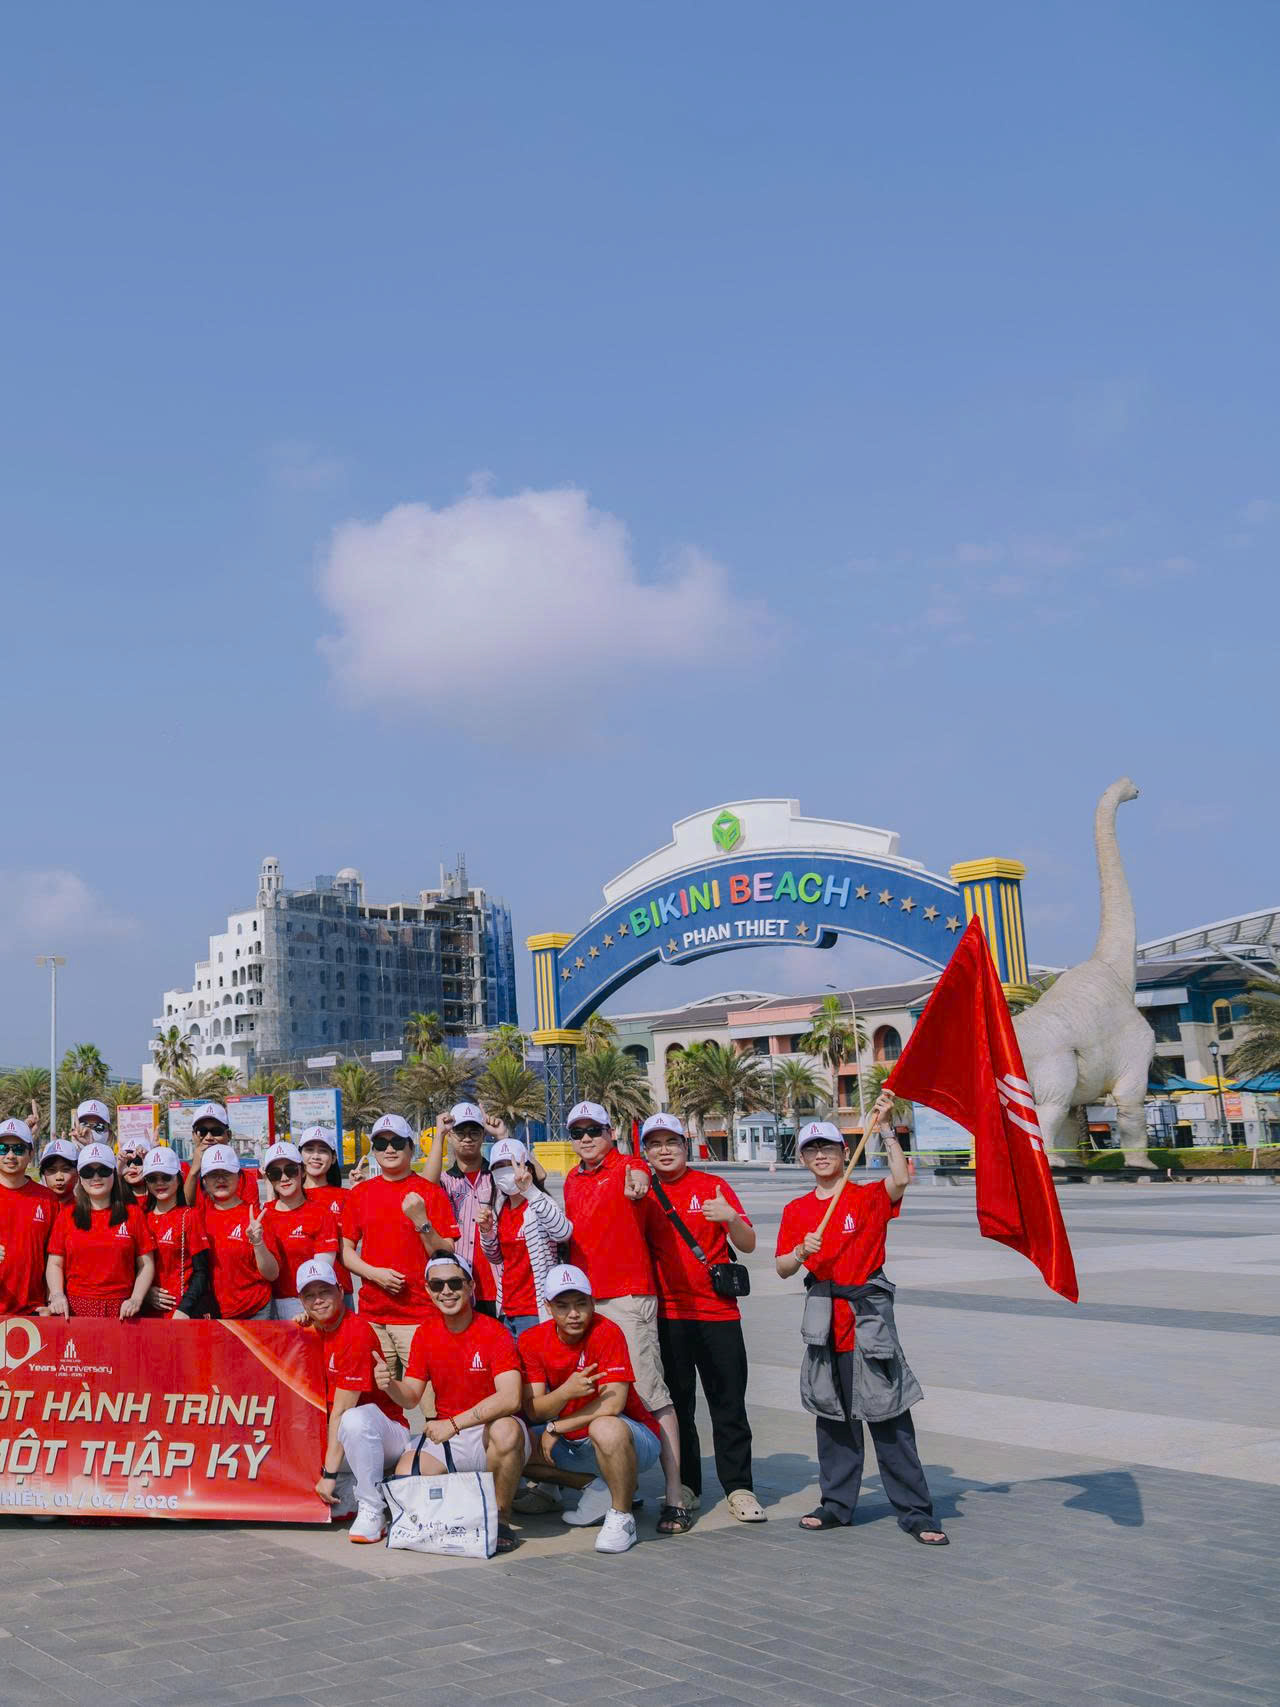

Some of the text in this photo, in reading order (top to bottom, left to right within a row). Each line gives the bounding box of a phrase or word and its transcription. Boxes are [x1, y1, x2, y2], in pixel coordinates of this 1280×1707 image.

[628, 871, 851, 937] BIKINI BEACH
[682, 919, 790, 949] PHAN THIET
[28, 1363, 113, 1375] Years Anniversary
[41, 1382, 152, 1423] HÀNH
[164, 1384, 276, 1426] TRÌNH
[80, 1430, 195, 1487] THẬP
[206, 1430, 272, 1480] KỶ
[53, 1494, 72, 1506] 01
[91, 1494, 113, 1508] 04
[134, 1494, 178, 1510] 2026
